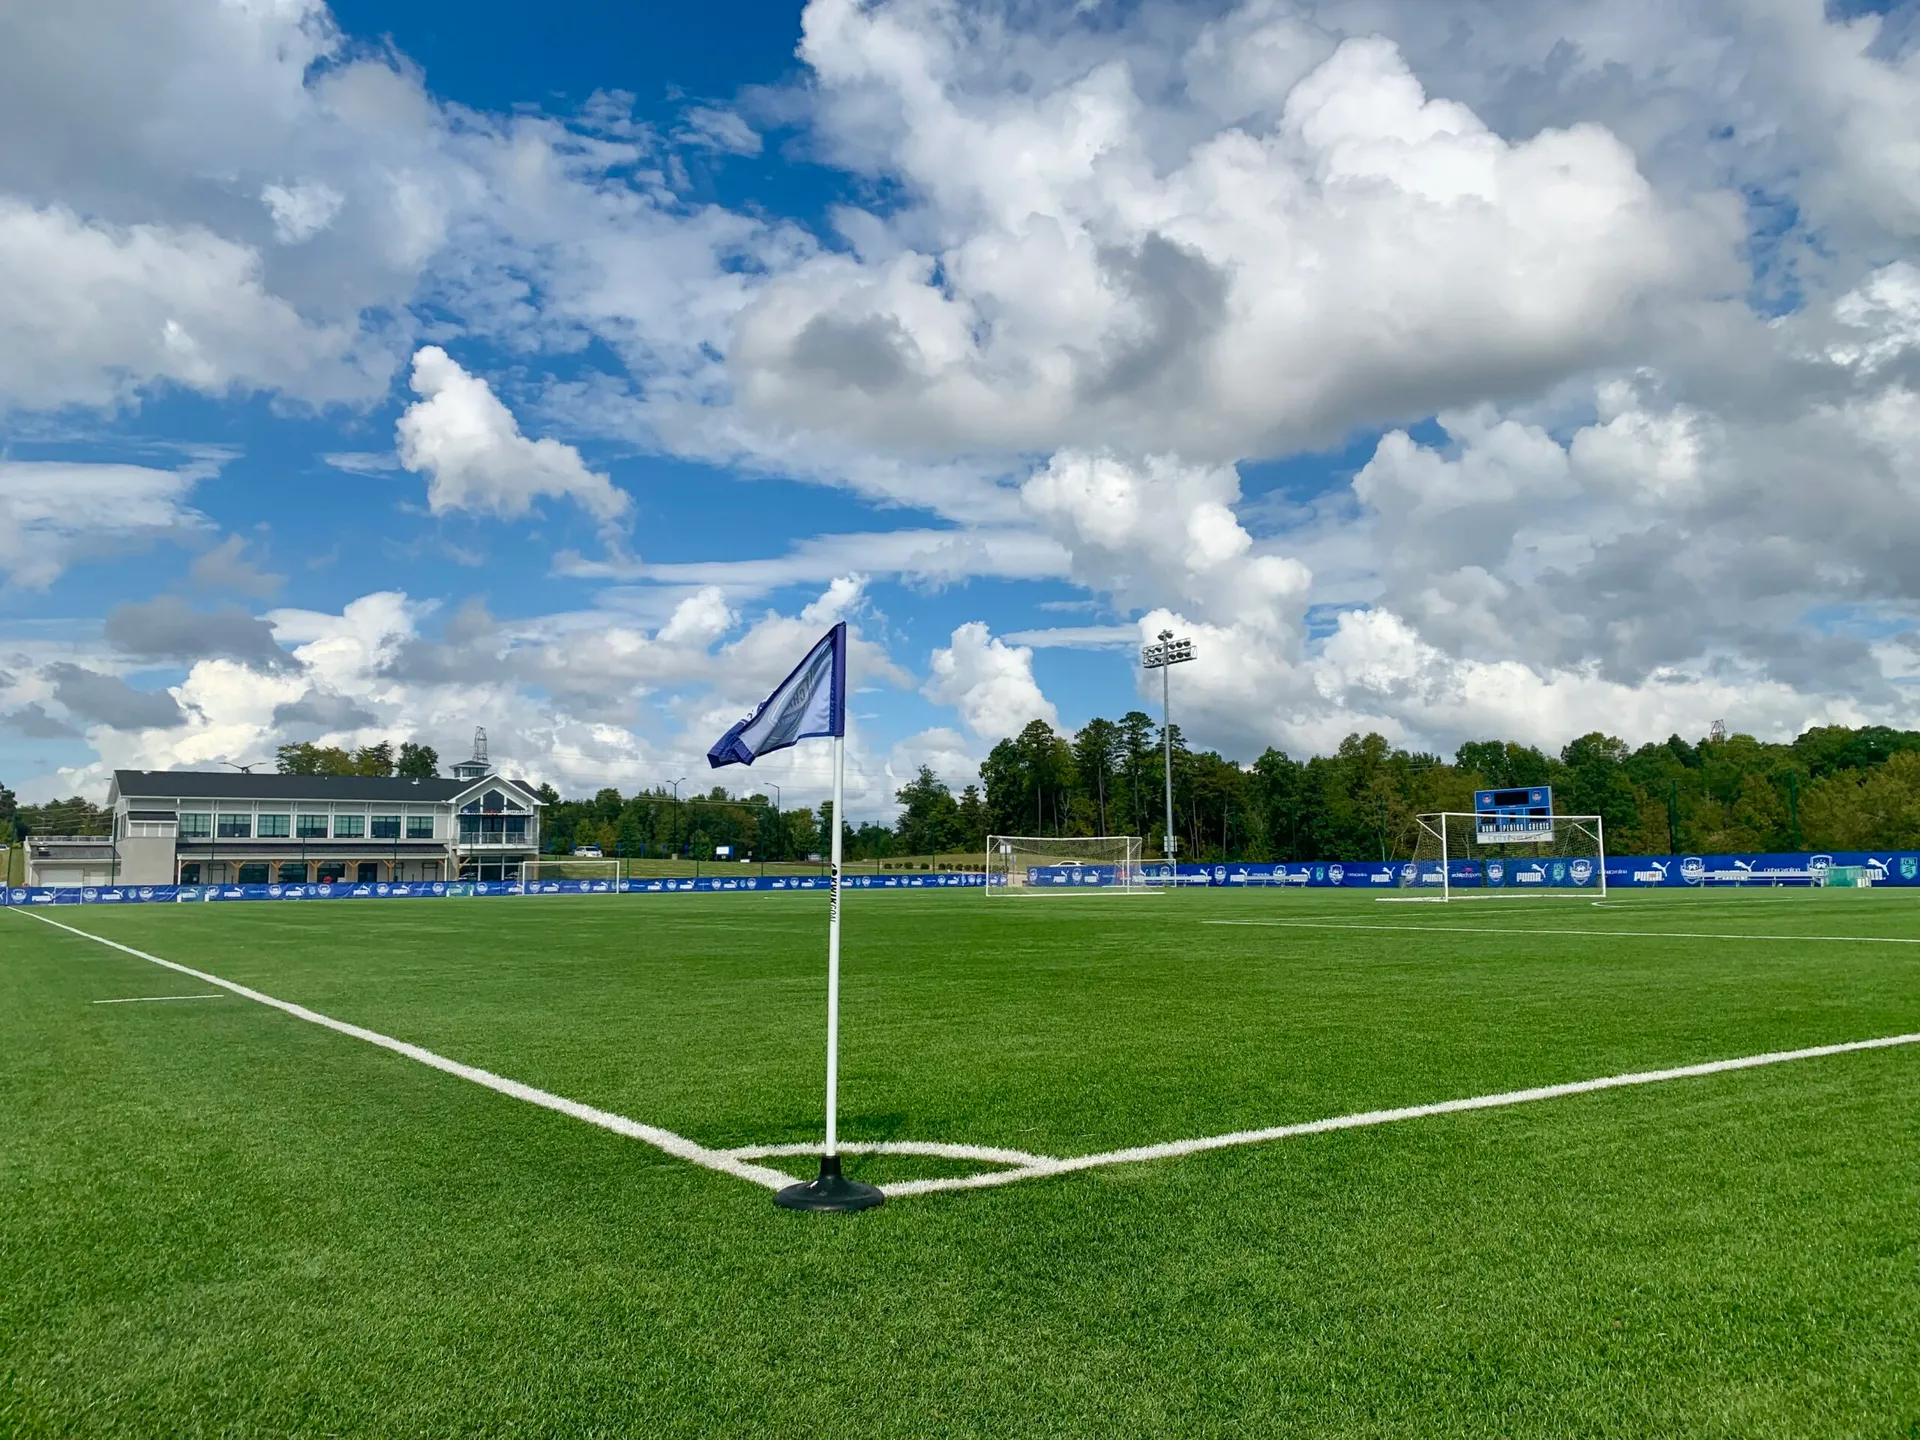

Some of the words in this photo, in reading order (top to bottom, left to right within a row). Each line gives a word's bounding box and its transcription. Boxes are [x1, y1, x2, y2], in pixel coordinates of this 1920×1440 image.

[1482, 824, 1497, 833] HOME
[1502, 823, 1524, 832] PERIOD
[1528, 822, 1550, 831] GUESTS
[1516, 872, 1542, 882] PUMA
[1633, 871, 1663, 882] PUMA
